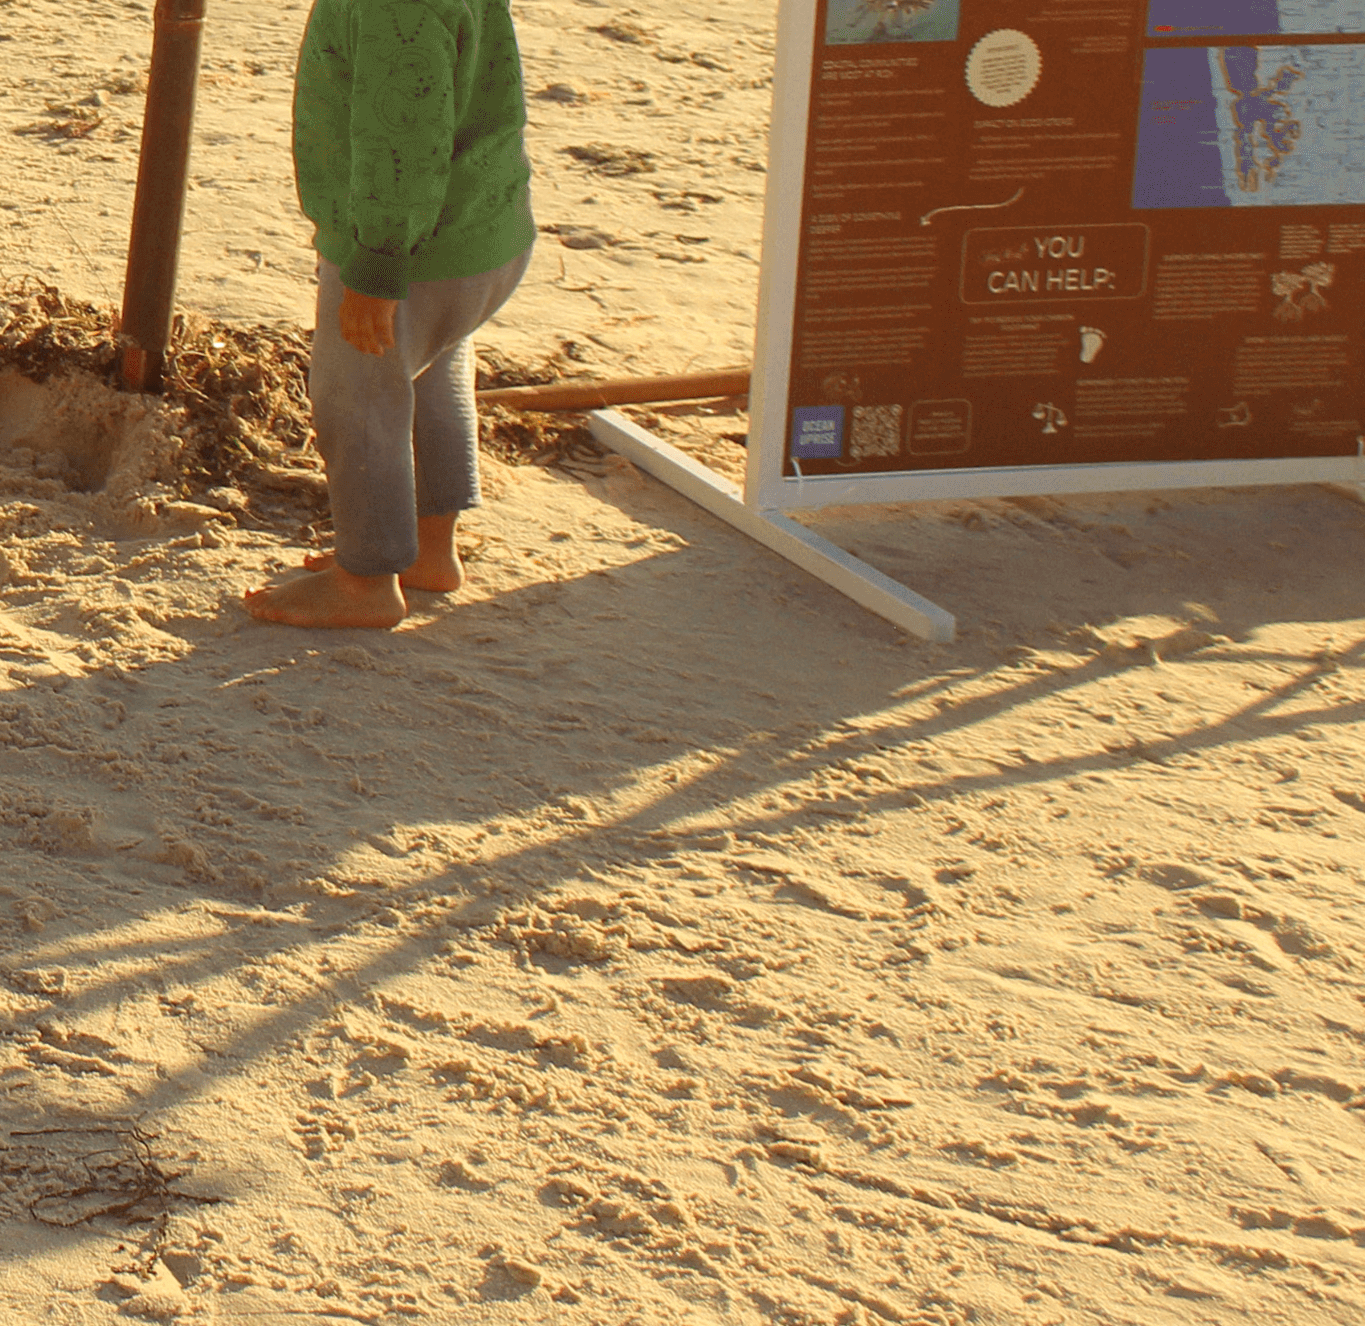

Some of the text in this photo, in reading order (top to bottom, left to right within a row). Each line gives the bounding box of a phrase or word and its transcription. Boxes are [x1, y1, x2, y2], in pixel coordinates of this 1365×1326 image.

[1034, 236, 1085, 259] YOU
[987, 268, 1116, 293] CAN HELP:
